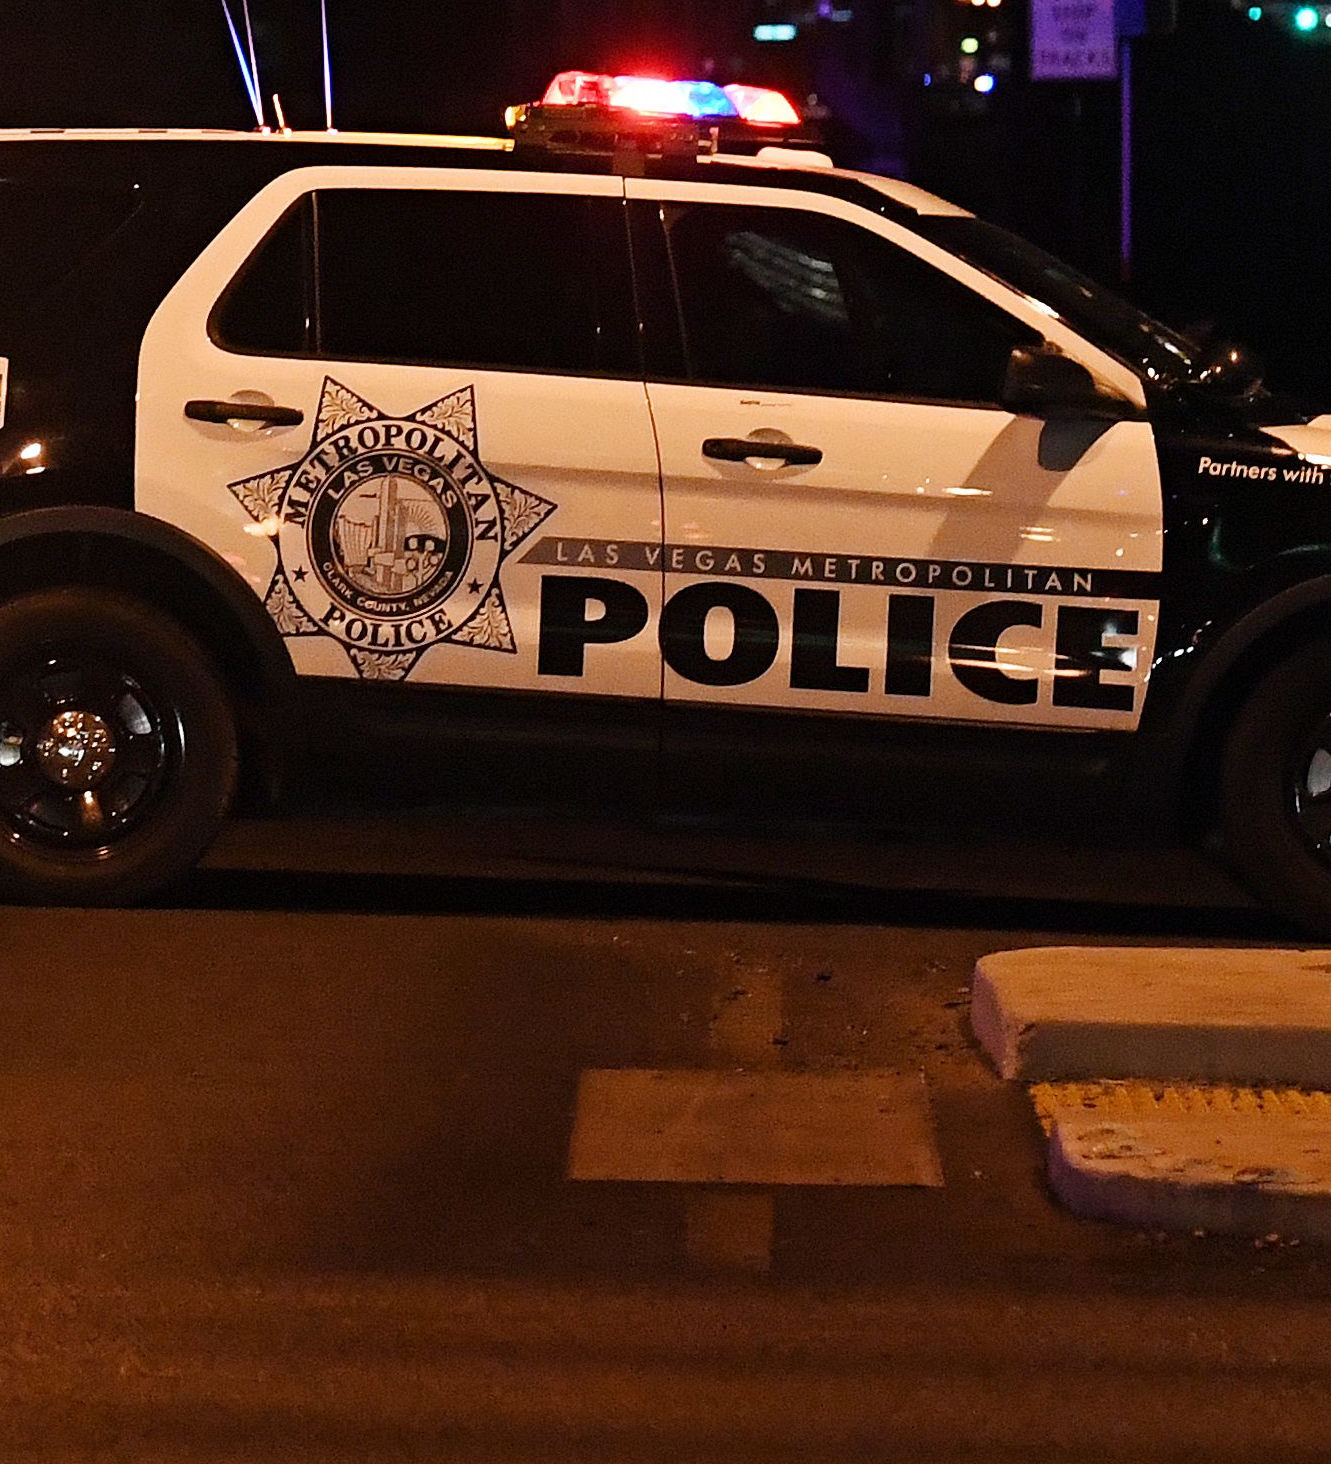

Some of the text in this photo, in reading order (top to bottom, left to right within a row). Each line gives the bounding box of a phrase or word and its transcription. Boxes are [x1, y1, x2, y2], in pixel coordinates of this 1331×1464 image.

[284, 424, 499, 543] METROPOLITAN
[329, 456, 458, 509] LAS VEGAS
[1197, 456, 1325, 485] Partners with
[556, 542, 1094, 593] LAS VEGAS METROPOLITAN
[320, 602, 454, 648] POLICE
[537, 573, 1141, 712] POLICE
